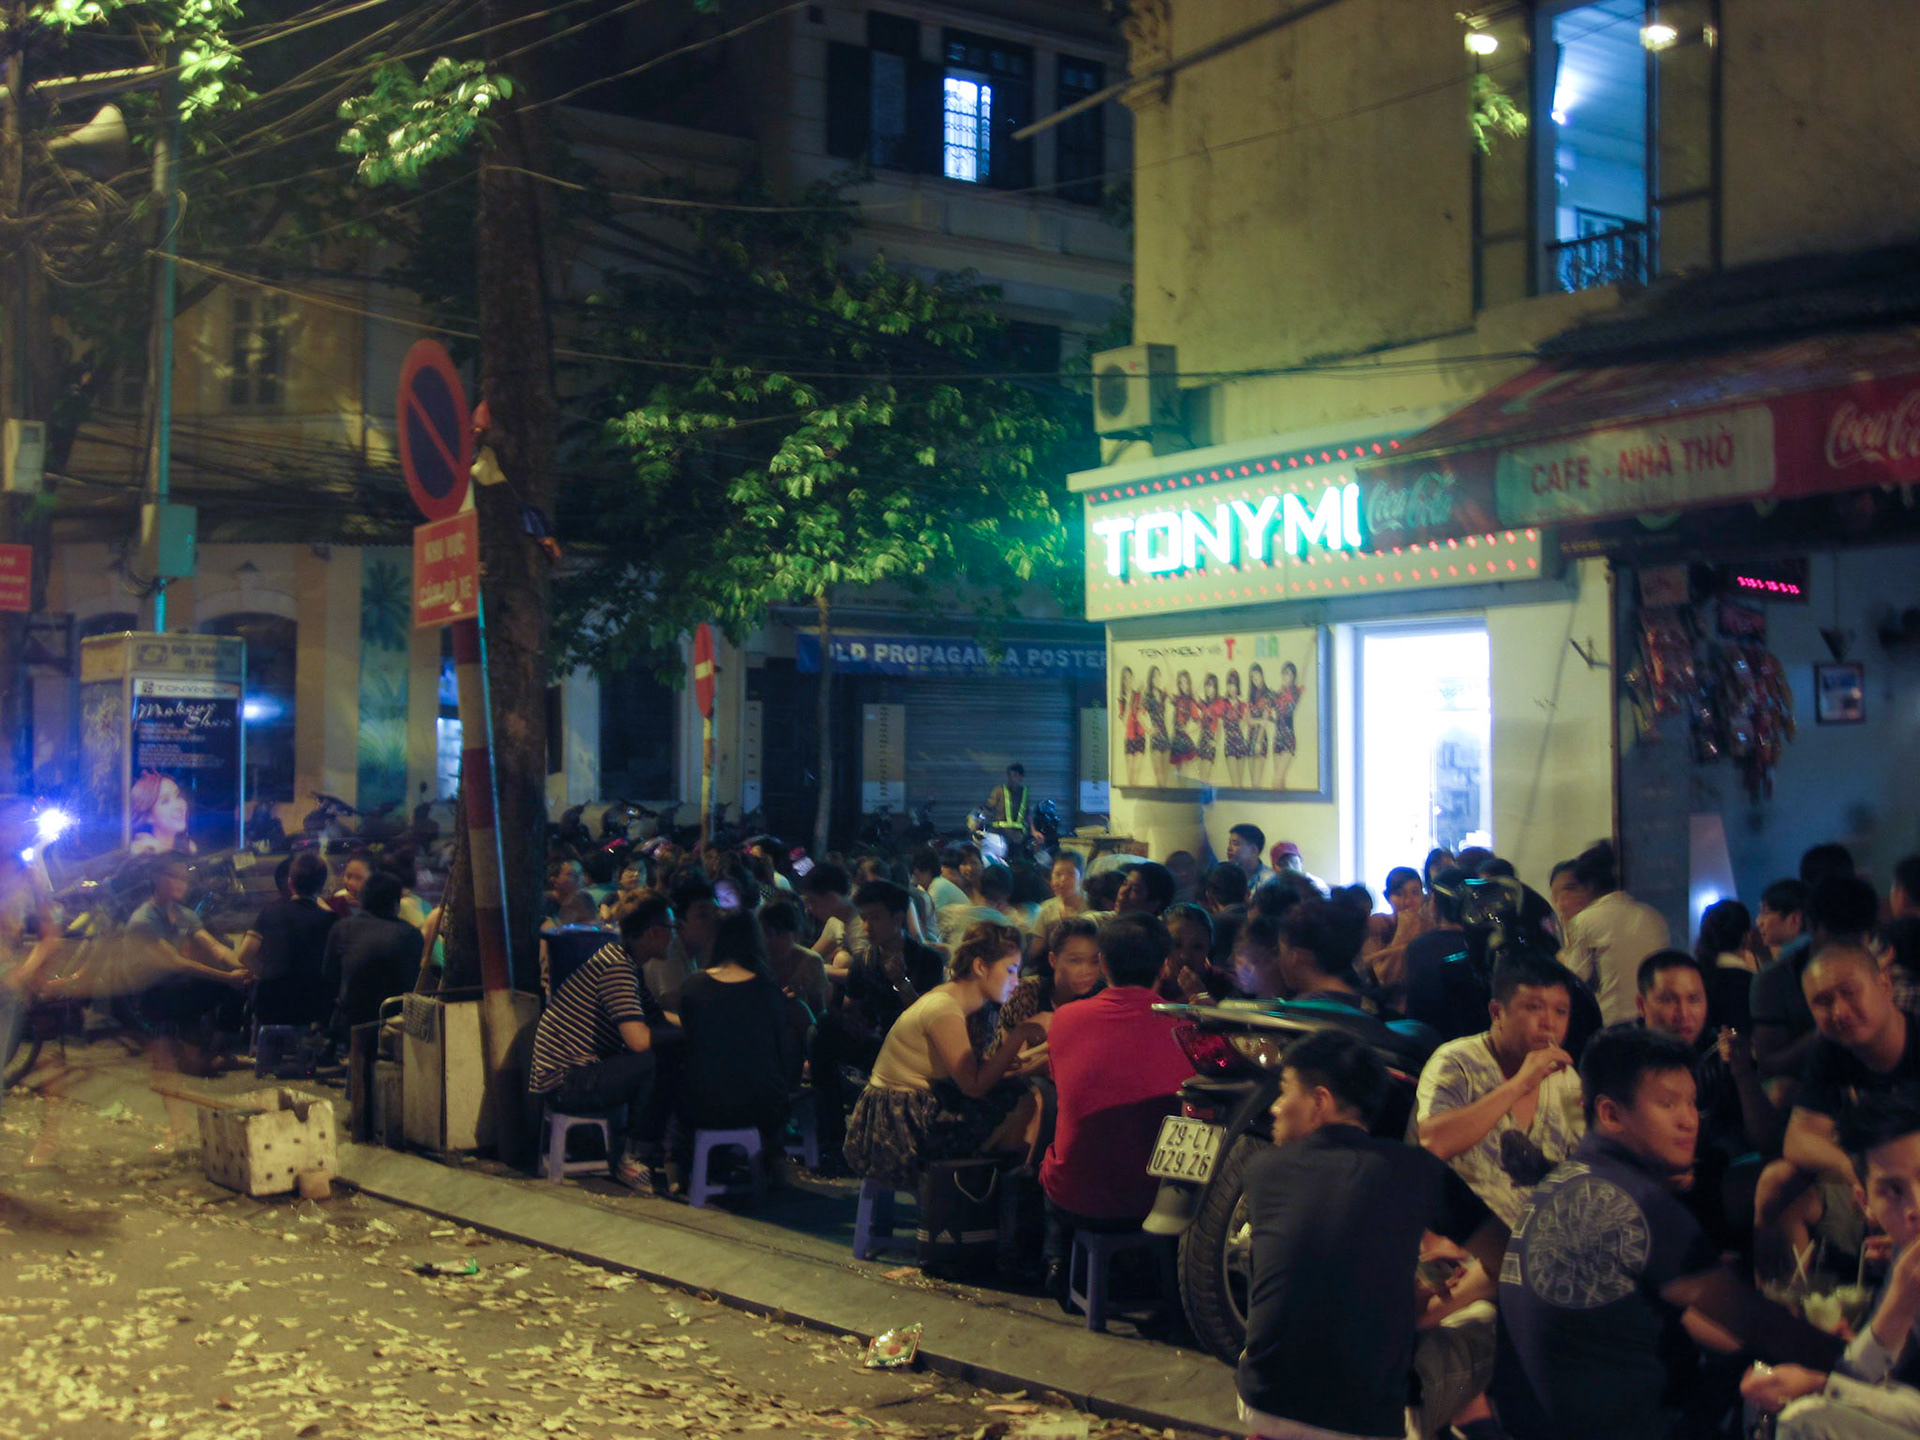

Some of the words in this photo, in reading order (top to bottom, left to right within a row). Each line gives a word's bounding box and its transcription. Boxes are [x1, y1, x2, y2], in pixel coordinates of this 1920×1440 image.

[1531, 455, 1591, 497] CAFE
[873, 643, 1020, 667] PROPAGANA
[1166, 1123, 1214, 1151] 29-C1
[1153, 1147, 1211, 1177] 029.26
